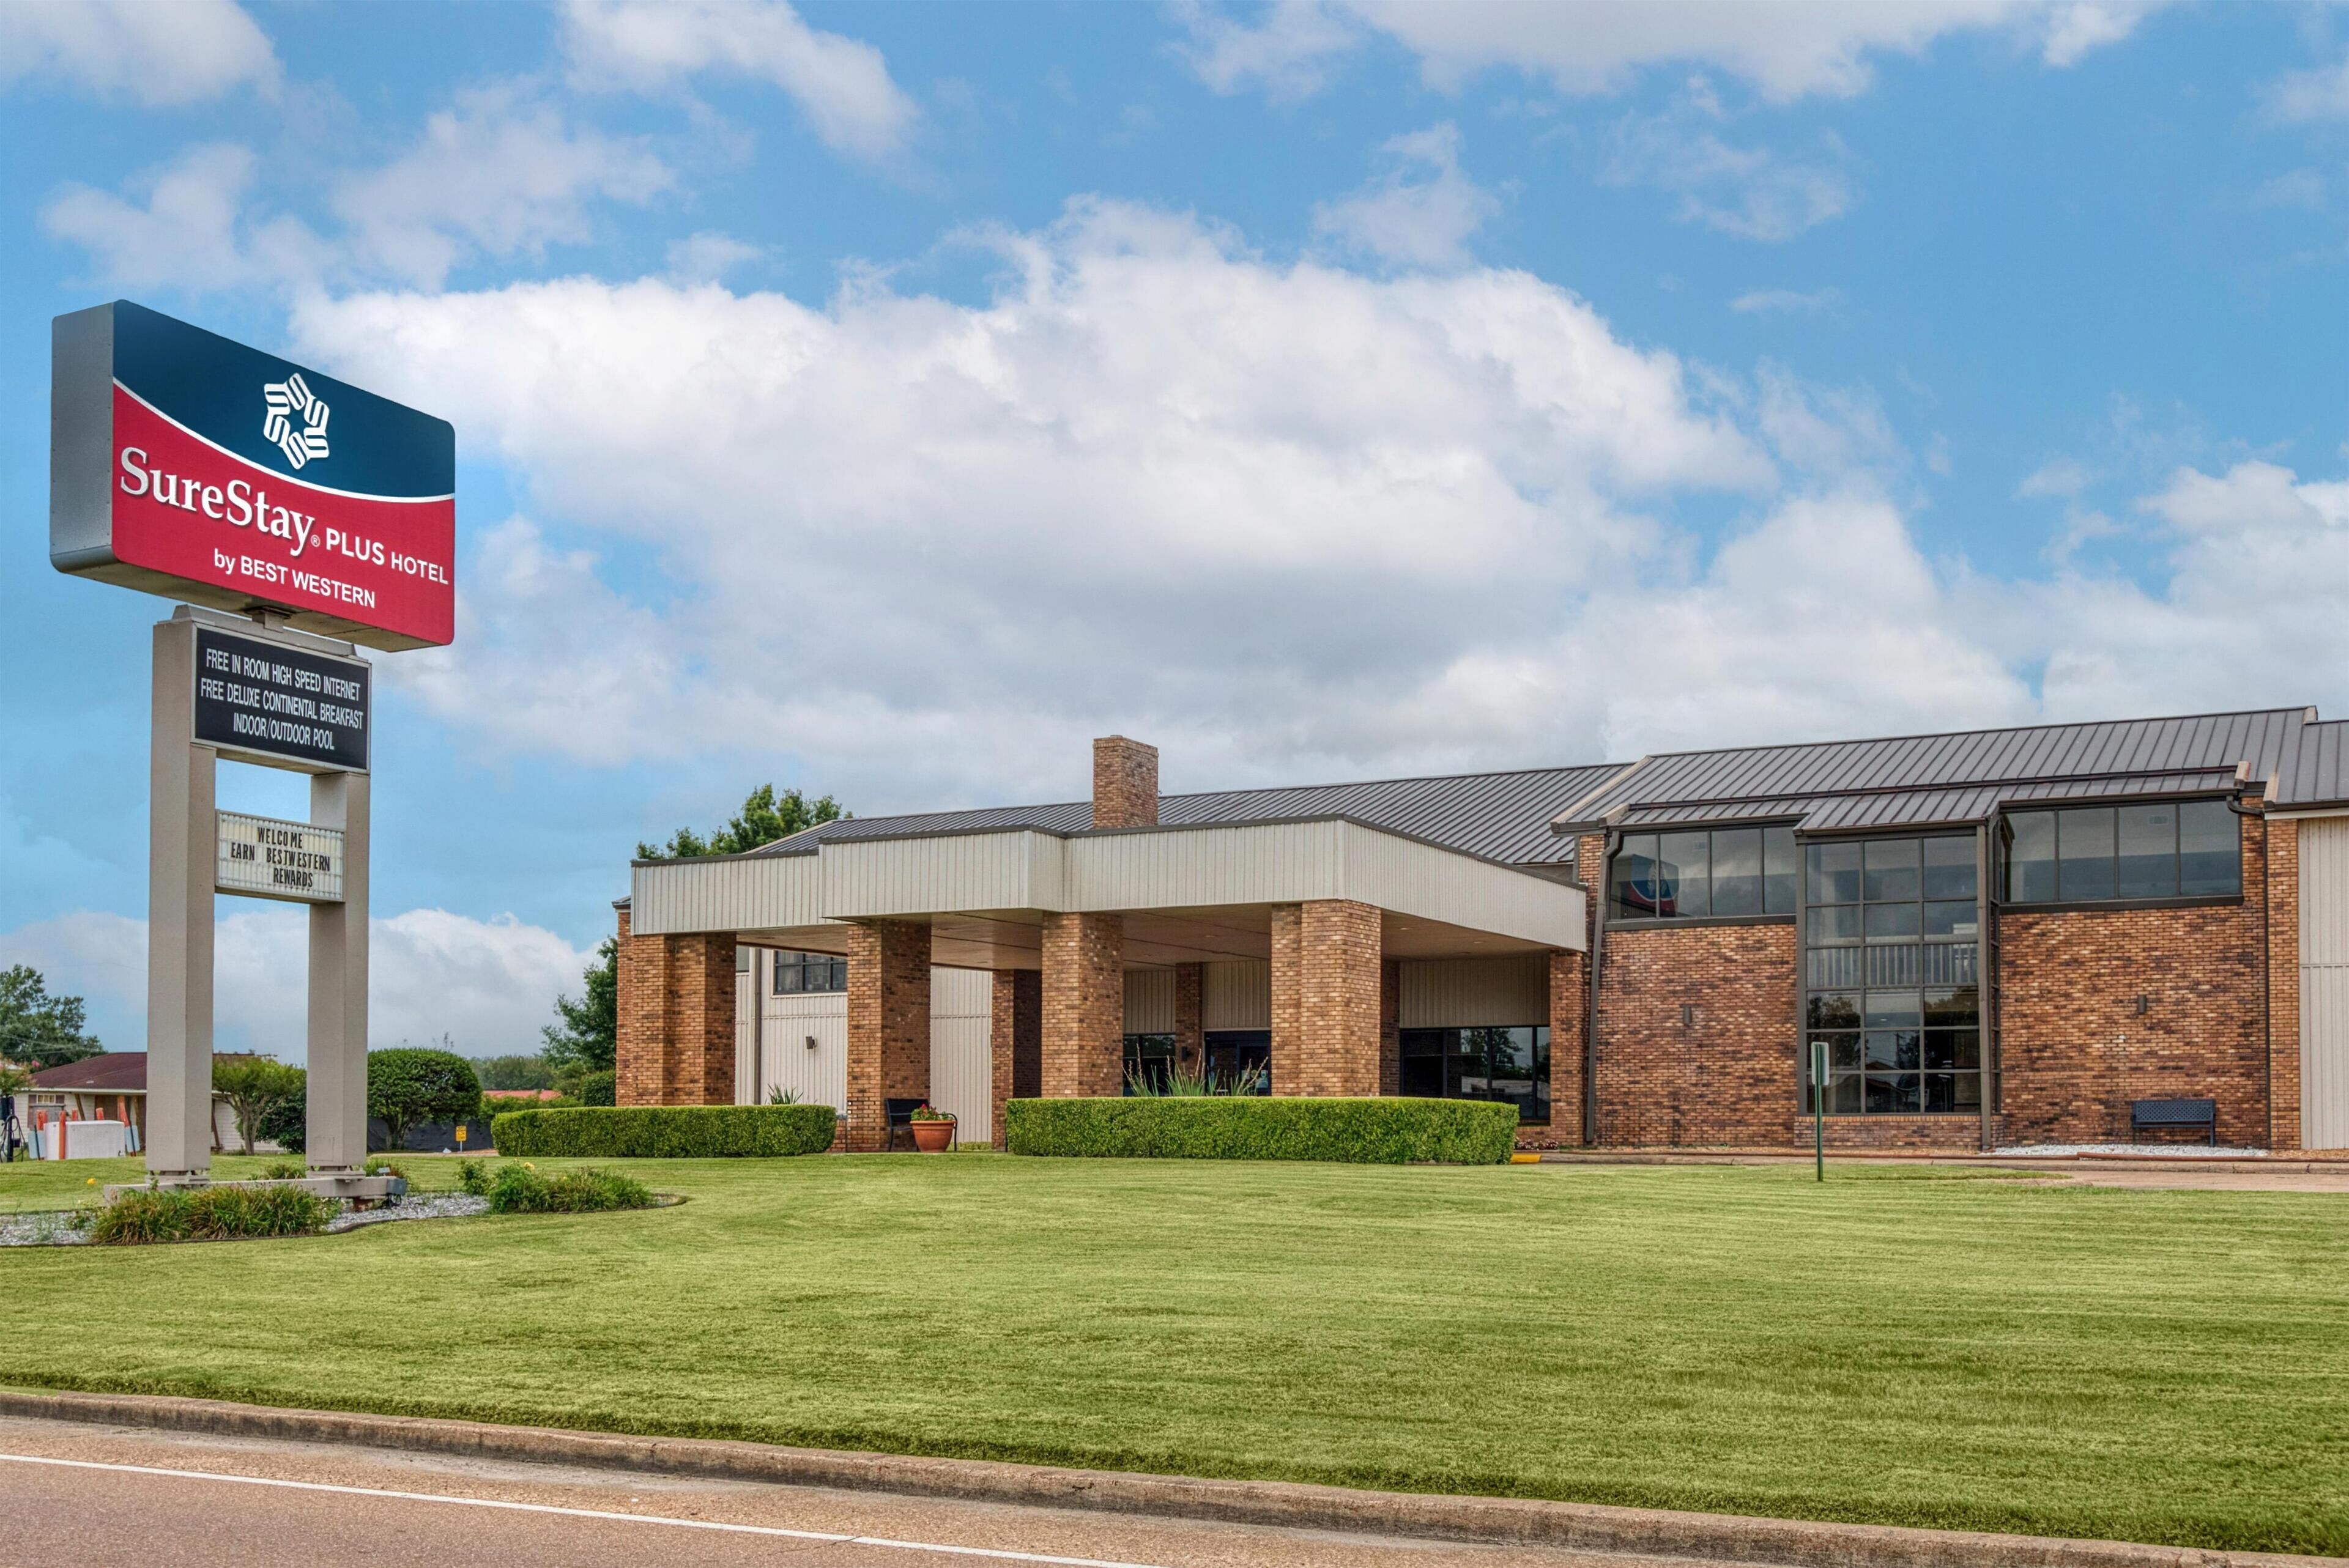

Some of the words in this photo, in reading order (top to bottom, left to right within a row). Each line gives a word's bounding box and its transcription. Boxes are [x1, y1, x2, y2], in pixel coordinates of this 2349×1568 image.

[214, 549, 235, 574] by
[240, 556, 288, 584] BEST
[292, 569, 376, 608] WESTERN
[326, 528, 384, 565] PLUS
[392, 552, 448, 585] HOTEL
[206, 648, 229, 671] FREE
[232, 654, 240, 674] IN
[244, 657, 269, 681] ROOM
[272, 664, 292, 686] HIGH
[295, 669, 321, 692] SPEED
[324, 676, 360, 701] INTERNET
[201, 678, 224, 700] FREE
[227, 683, 260, 708] DELUXE
[263, 690, 317, 720] CONTINENTAL
[320, 703, 363, 729] BREAKFAST
[234, 712, 311, 745] INDOOR/OUTDOOR
[313, 728, 335, 750] POOL
[231, 842, 255, 860] EARN
[273, 867, 313, 887] REWARDS
